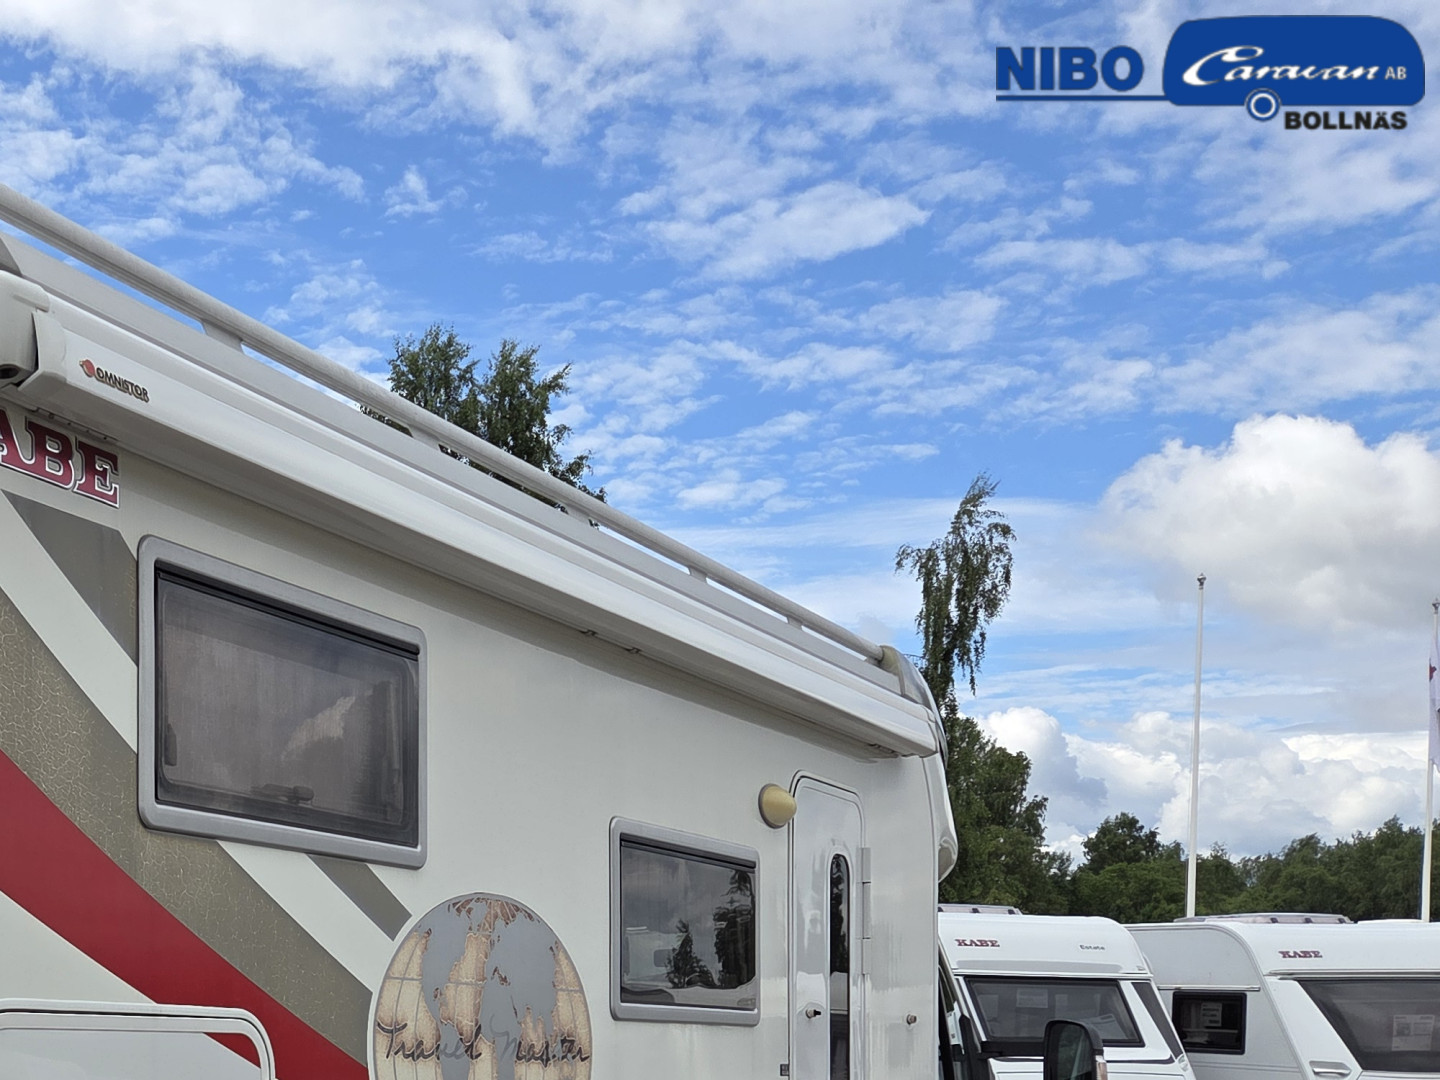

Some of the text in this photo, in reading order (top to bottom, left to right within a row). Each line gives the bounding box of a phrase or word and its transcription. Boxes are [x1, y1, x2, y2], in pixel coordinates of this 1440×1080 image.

[96, 367, 150, 403] OMNISTOR
[955, 938, 1000, 948] KABE
[1278, 950, 1323, 959] KABE
